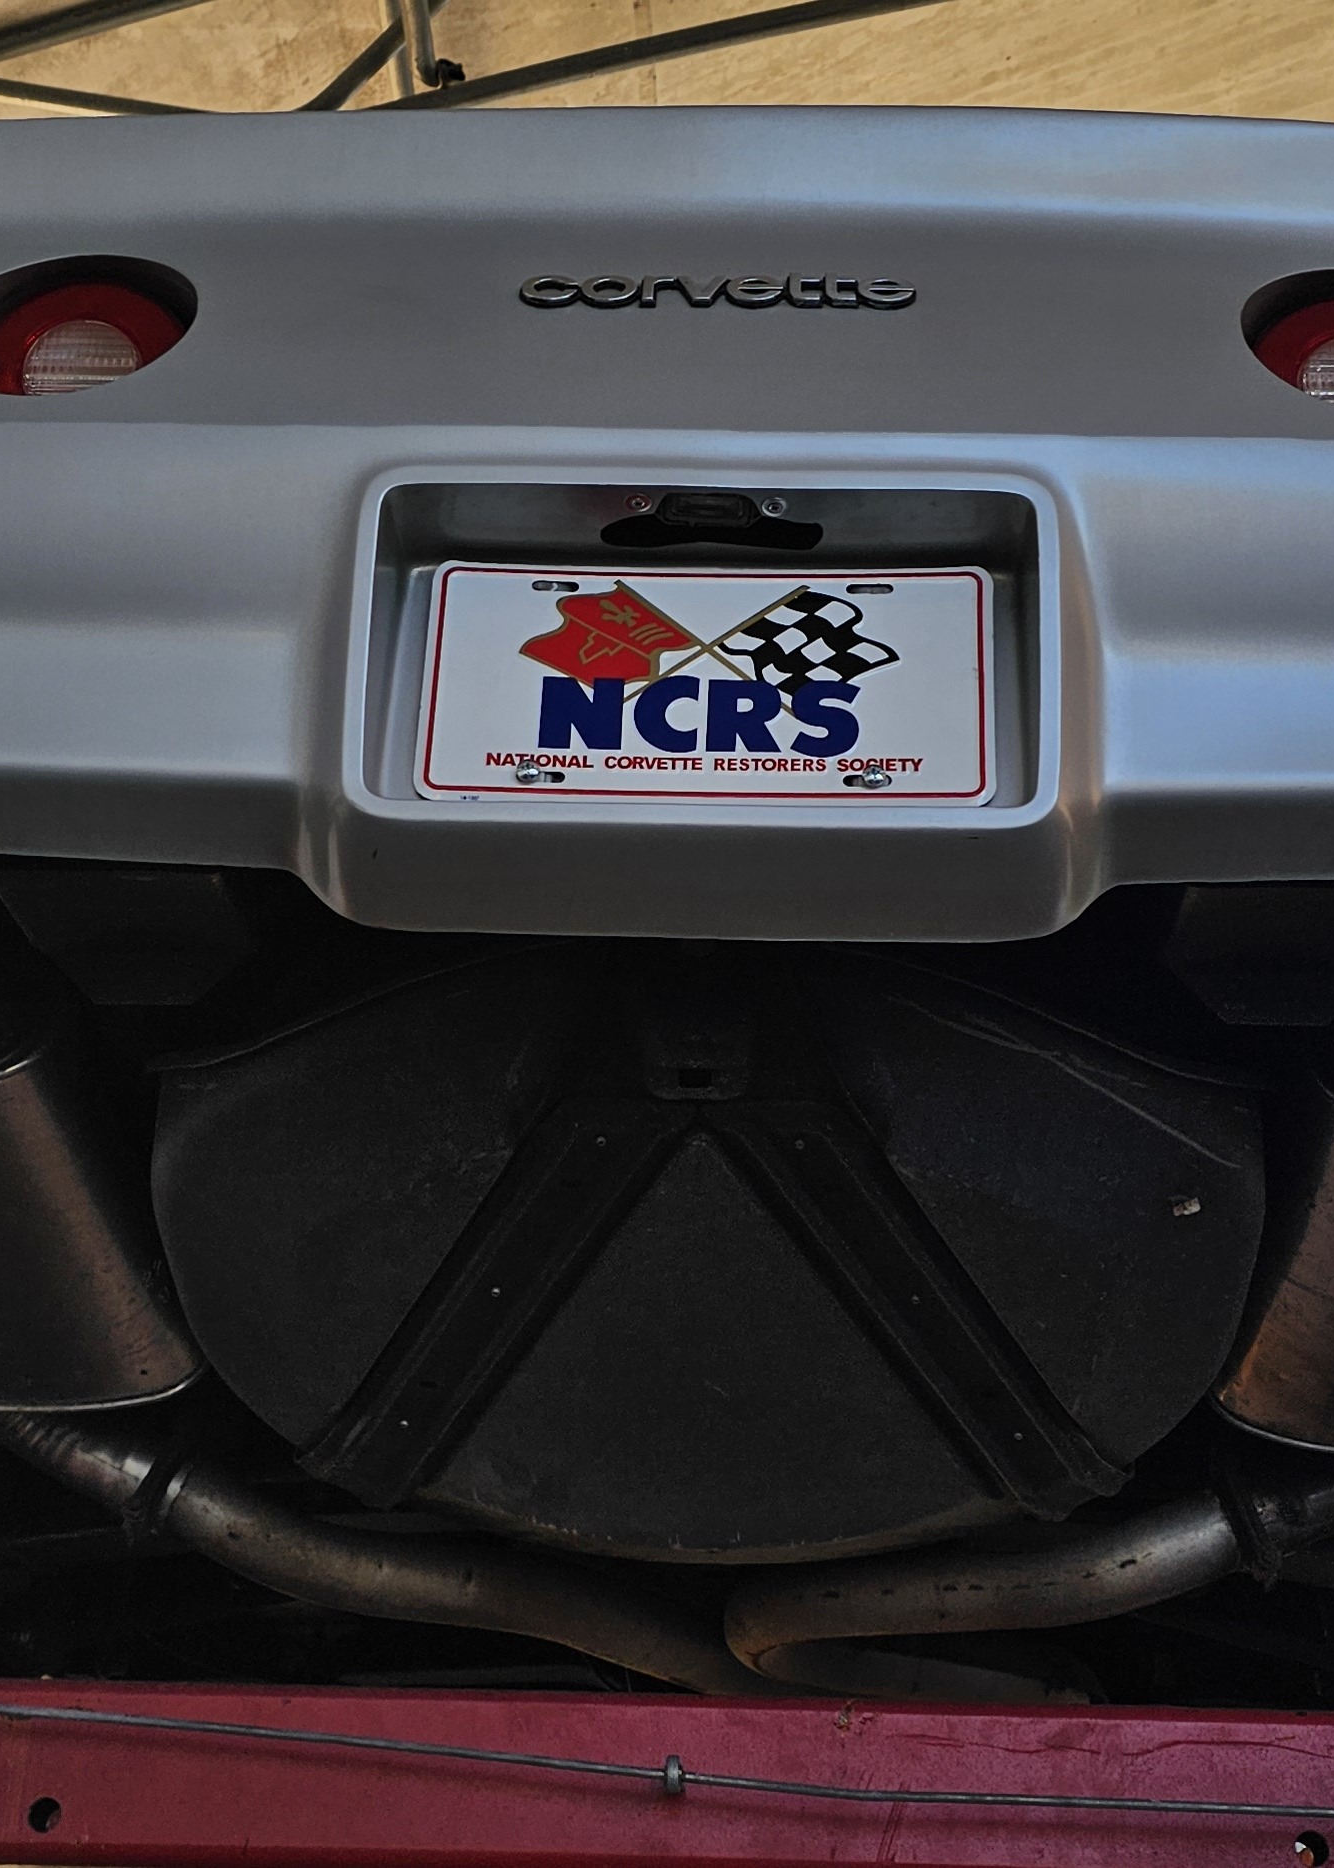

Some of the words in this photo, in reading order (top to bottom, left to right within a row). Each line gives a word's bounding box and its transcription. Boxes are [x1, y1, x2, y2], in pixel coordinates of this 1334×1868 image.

[519, 272, 917, 310] corvette
[537, 675, 861, 757] NCRS
[486, 752, 594, 768] NATIONAL
[604, 756, 703, 770] CORVETTE
[713, 758, 827, 772] RESTORERS
[837, 758, 924, 772] SOCIETY
